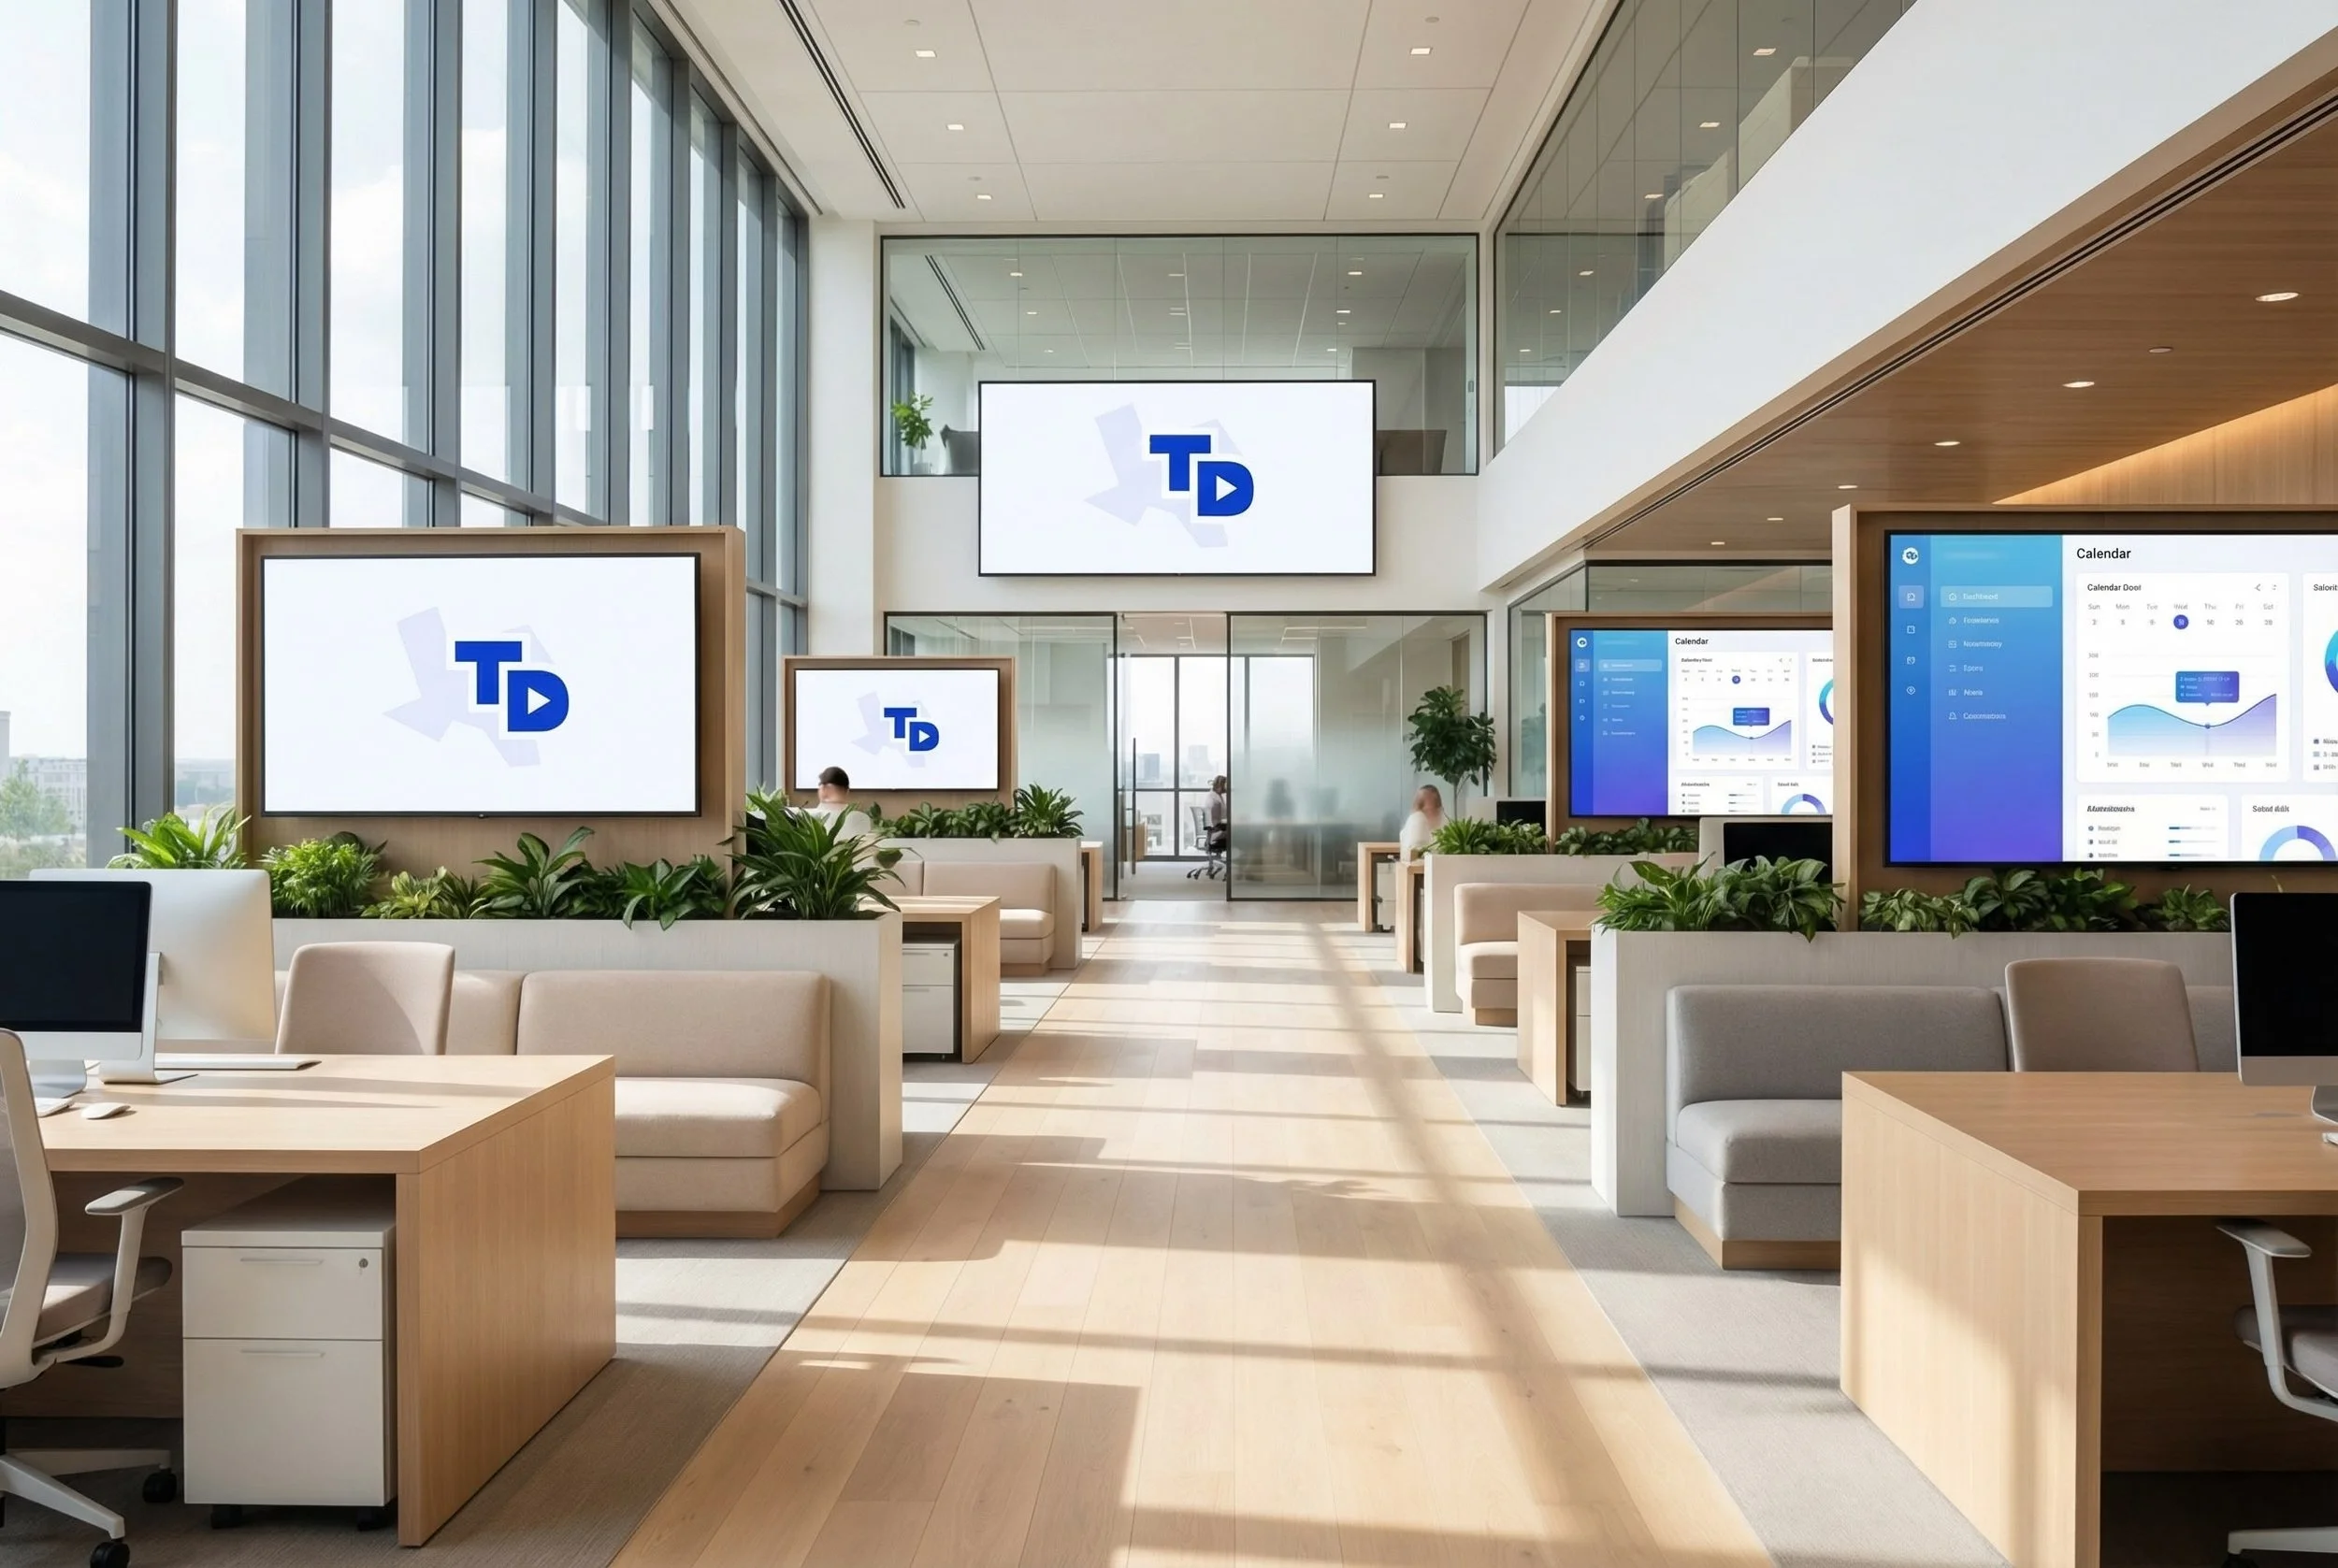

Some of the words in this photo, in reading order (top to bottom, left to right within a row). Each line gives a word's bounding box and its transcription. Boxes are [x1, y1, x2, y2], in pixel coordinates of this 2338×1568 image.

[1148, 434, 1254, 517] TD
[2076, 547, 2132, 560] Calendar
[2086, 583, 2122, 593] Calendar
[1674, 637, 1710, 646] Calendar
[455, 640, 570, 732] TD
[883, 707, 940, 752] TD
